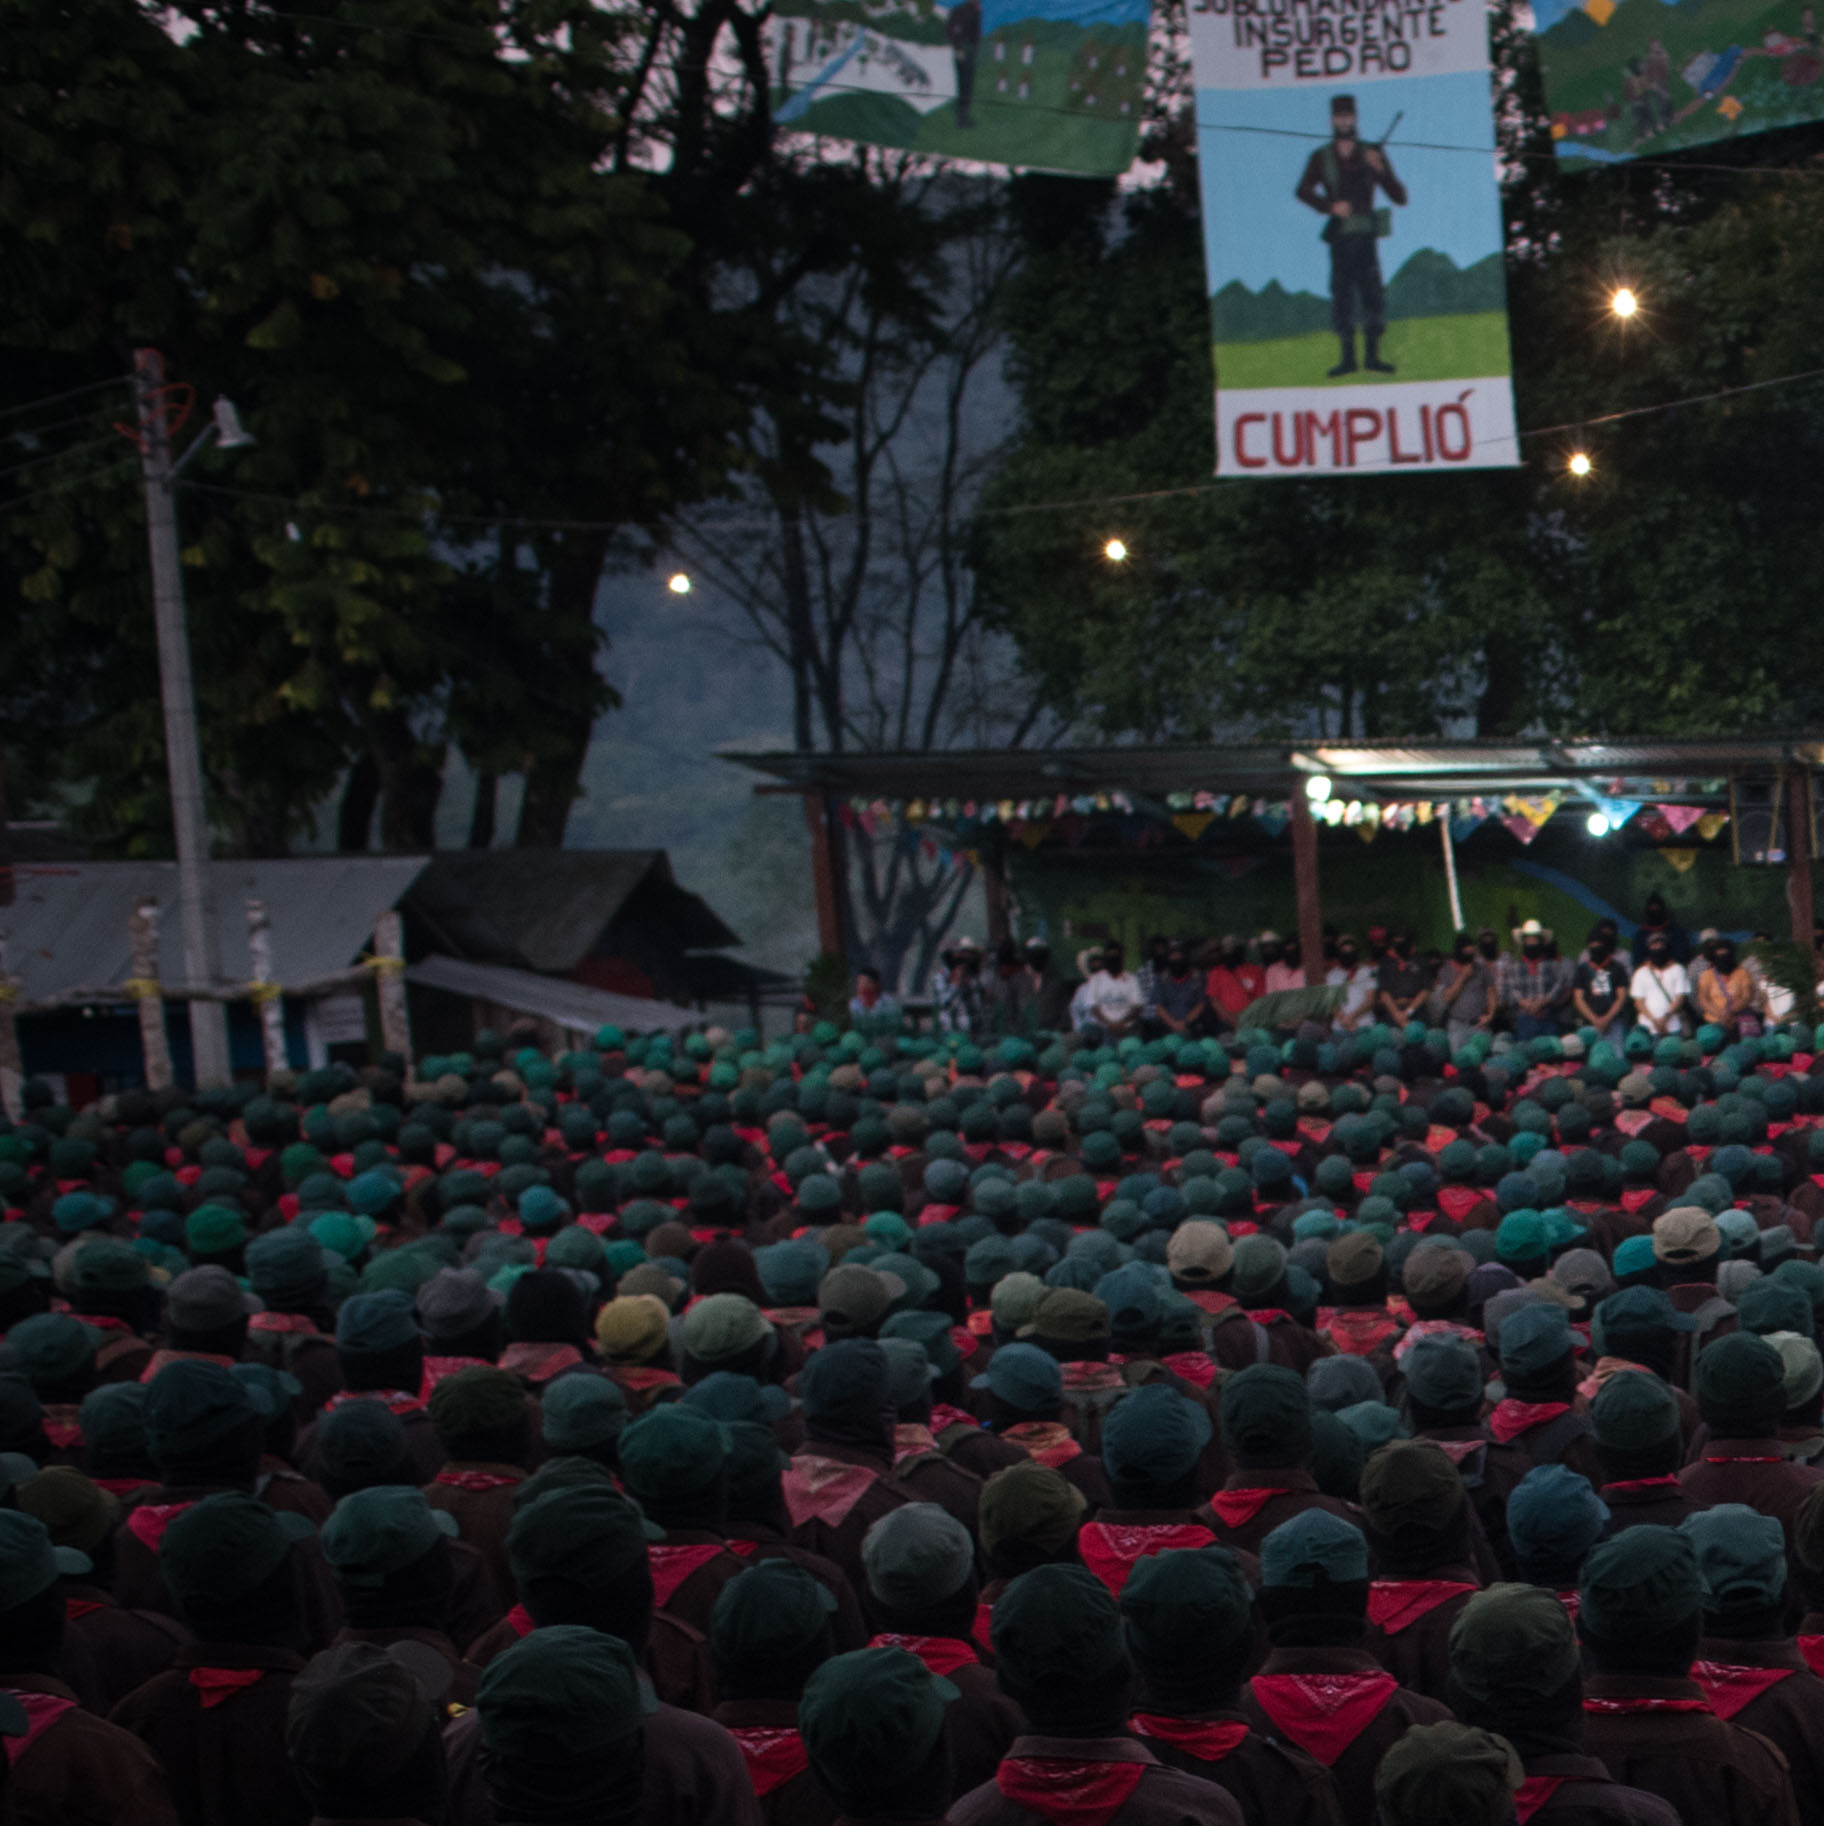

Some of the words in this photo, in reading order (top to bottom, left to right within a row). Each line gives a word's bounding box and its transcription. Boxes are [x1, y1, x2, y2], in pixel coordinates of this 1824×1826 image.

[1234, 6, 1446, 48] INSURGENTE
[1262, 41, 1411, 79] PEDRO
[1234, 388, 1475, 468] CUMPLIÓ
